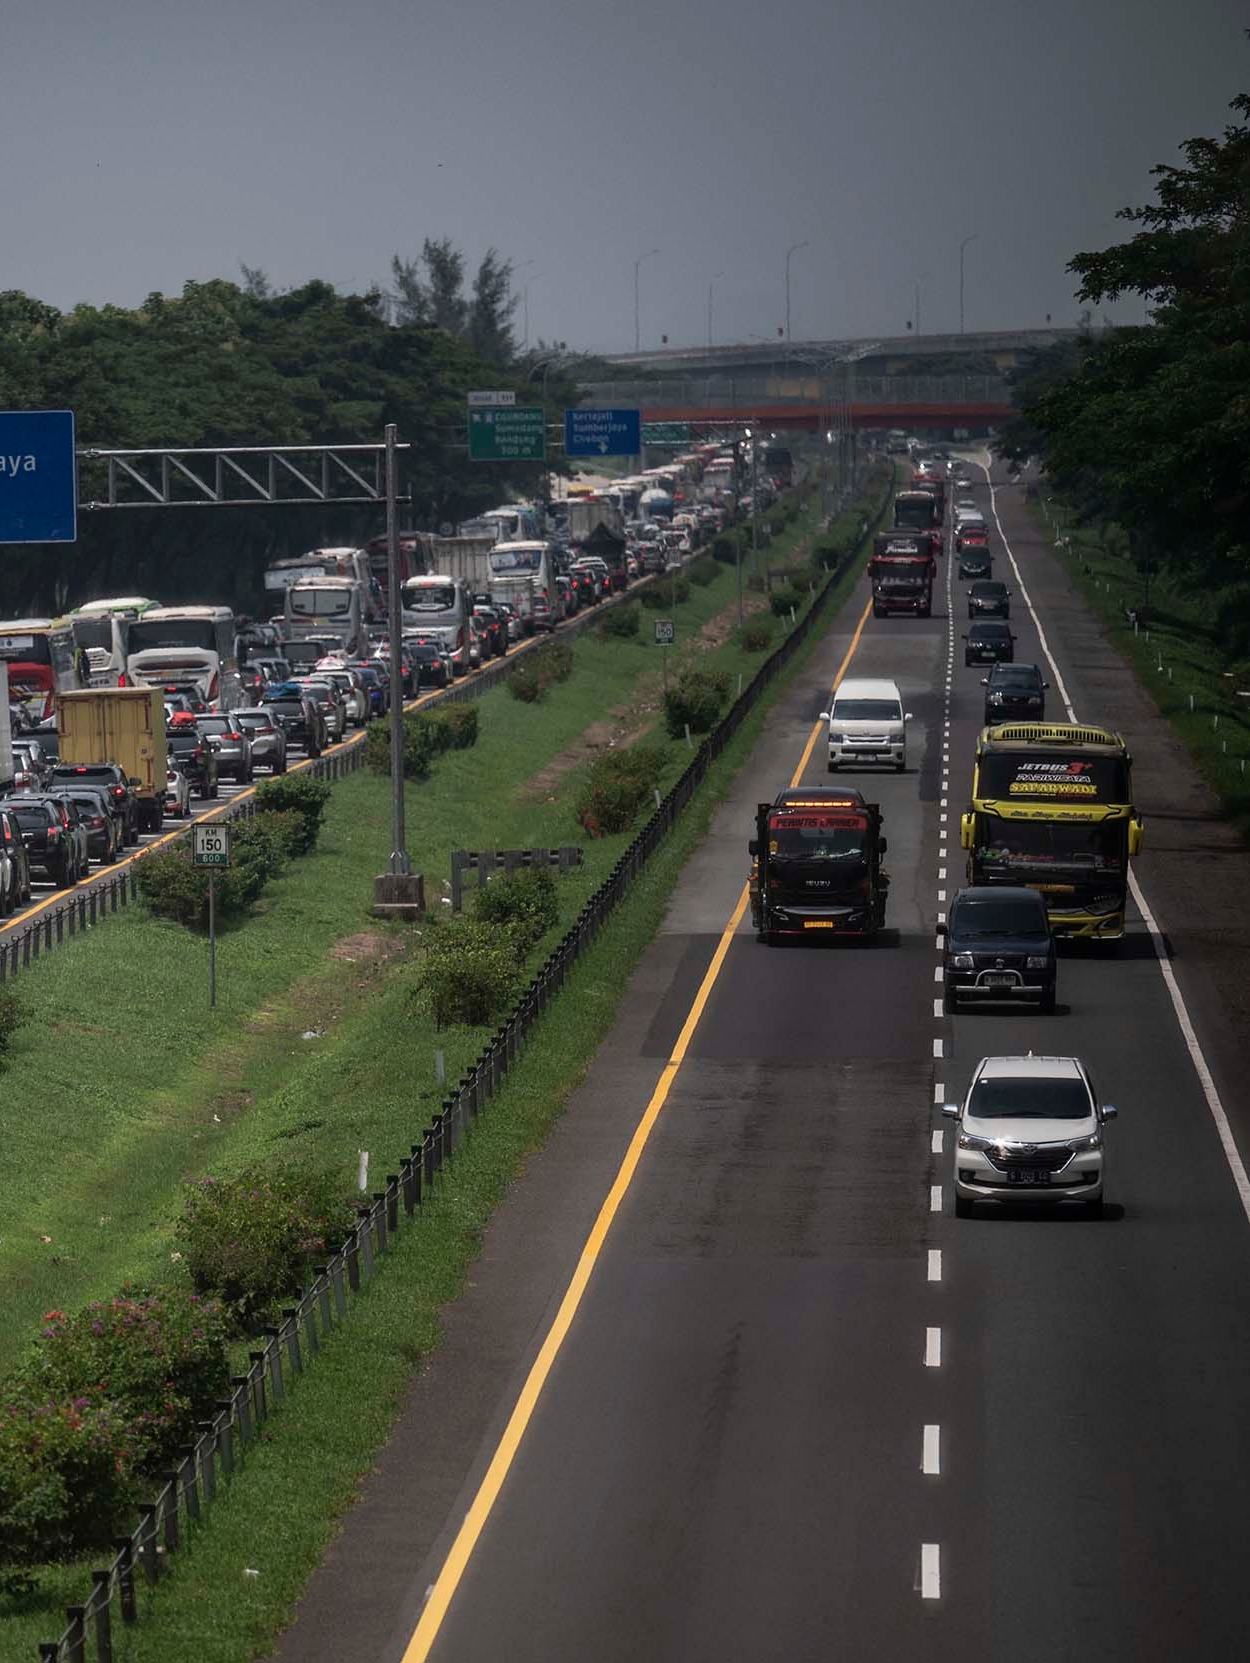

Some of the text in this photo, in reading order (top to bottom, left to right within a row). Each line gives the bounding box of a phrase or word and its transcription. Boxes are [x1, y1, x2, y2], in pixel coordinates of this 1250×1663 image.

[1015, 773, 1092, 783] PARIWISATA
[201, 838, 222, 851] 150
[202, 854, 220, 863] 600
